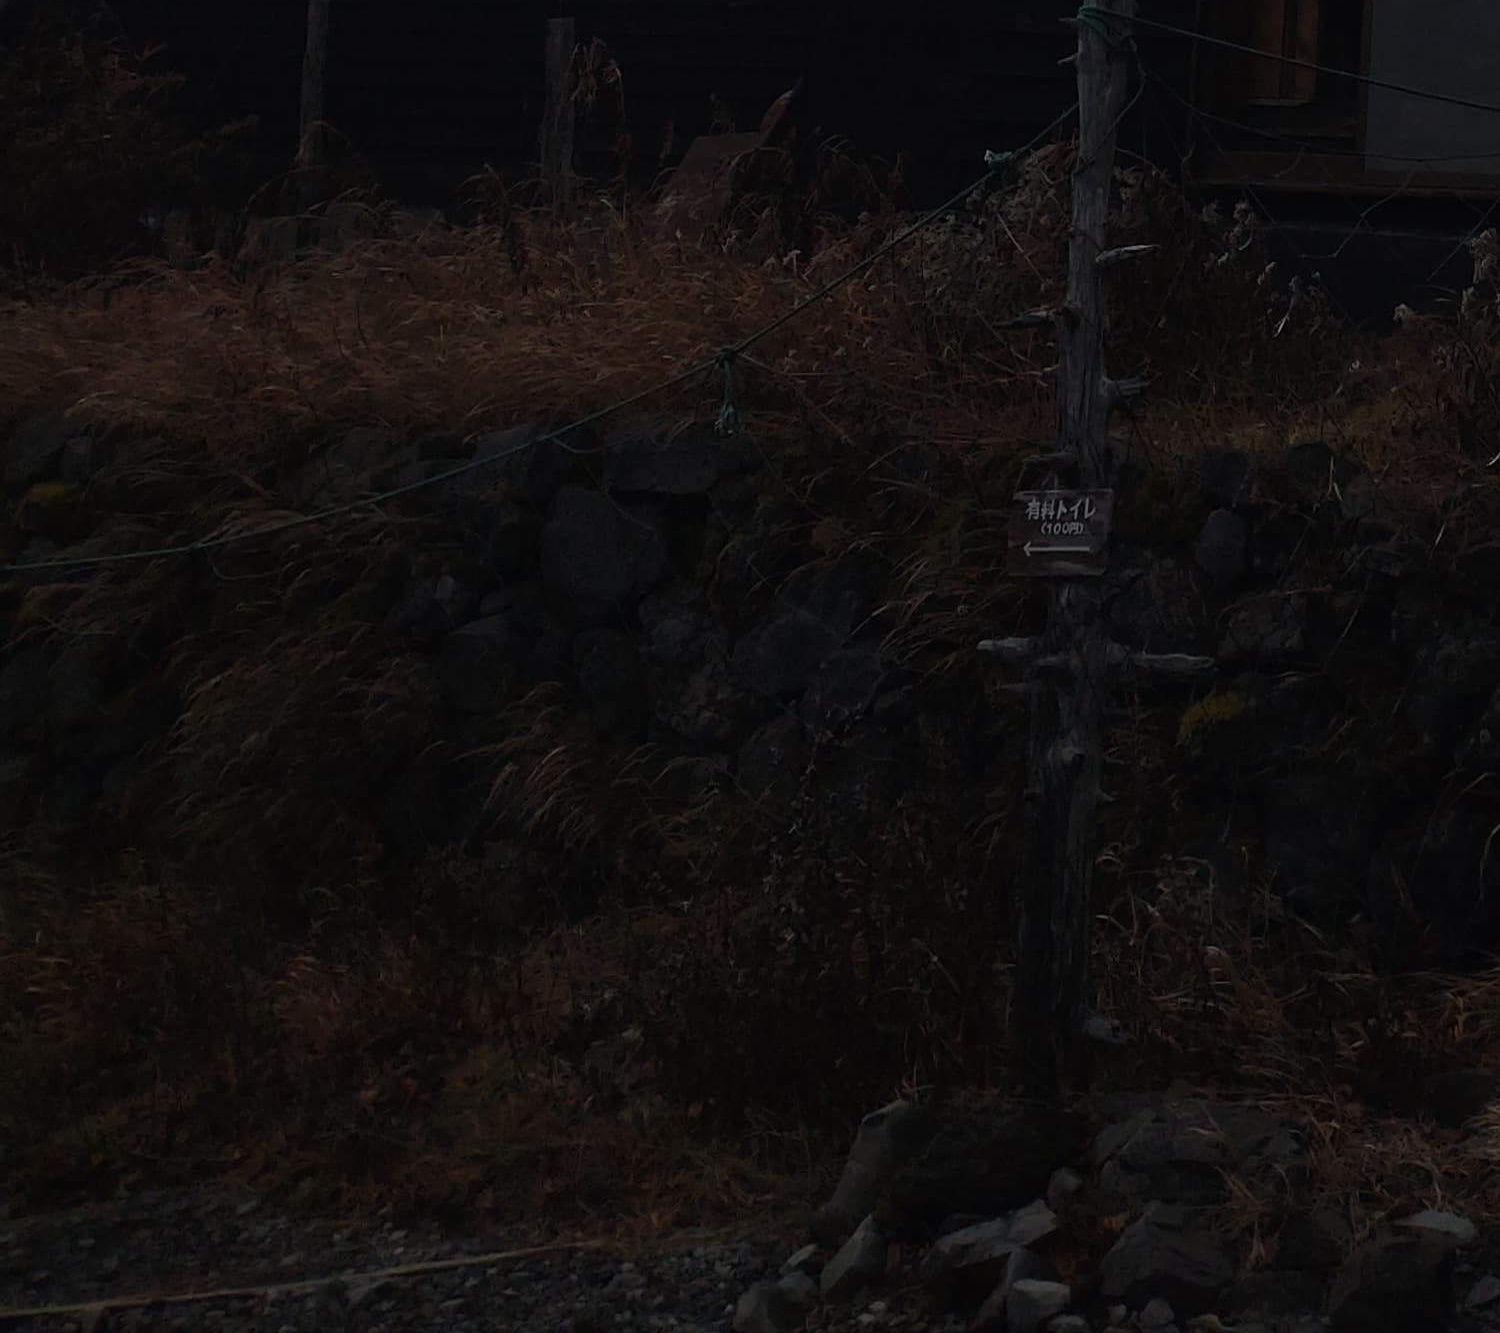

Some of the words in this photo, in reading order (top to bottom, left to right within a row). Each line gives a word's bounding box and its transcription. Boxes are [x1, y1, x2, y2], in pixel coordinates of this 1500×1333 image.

[1025, 497, 1096, 521] 有料トイレ
